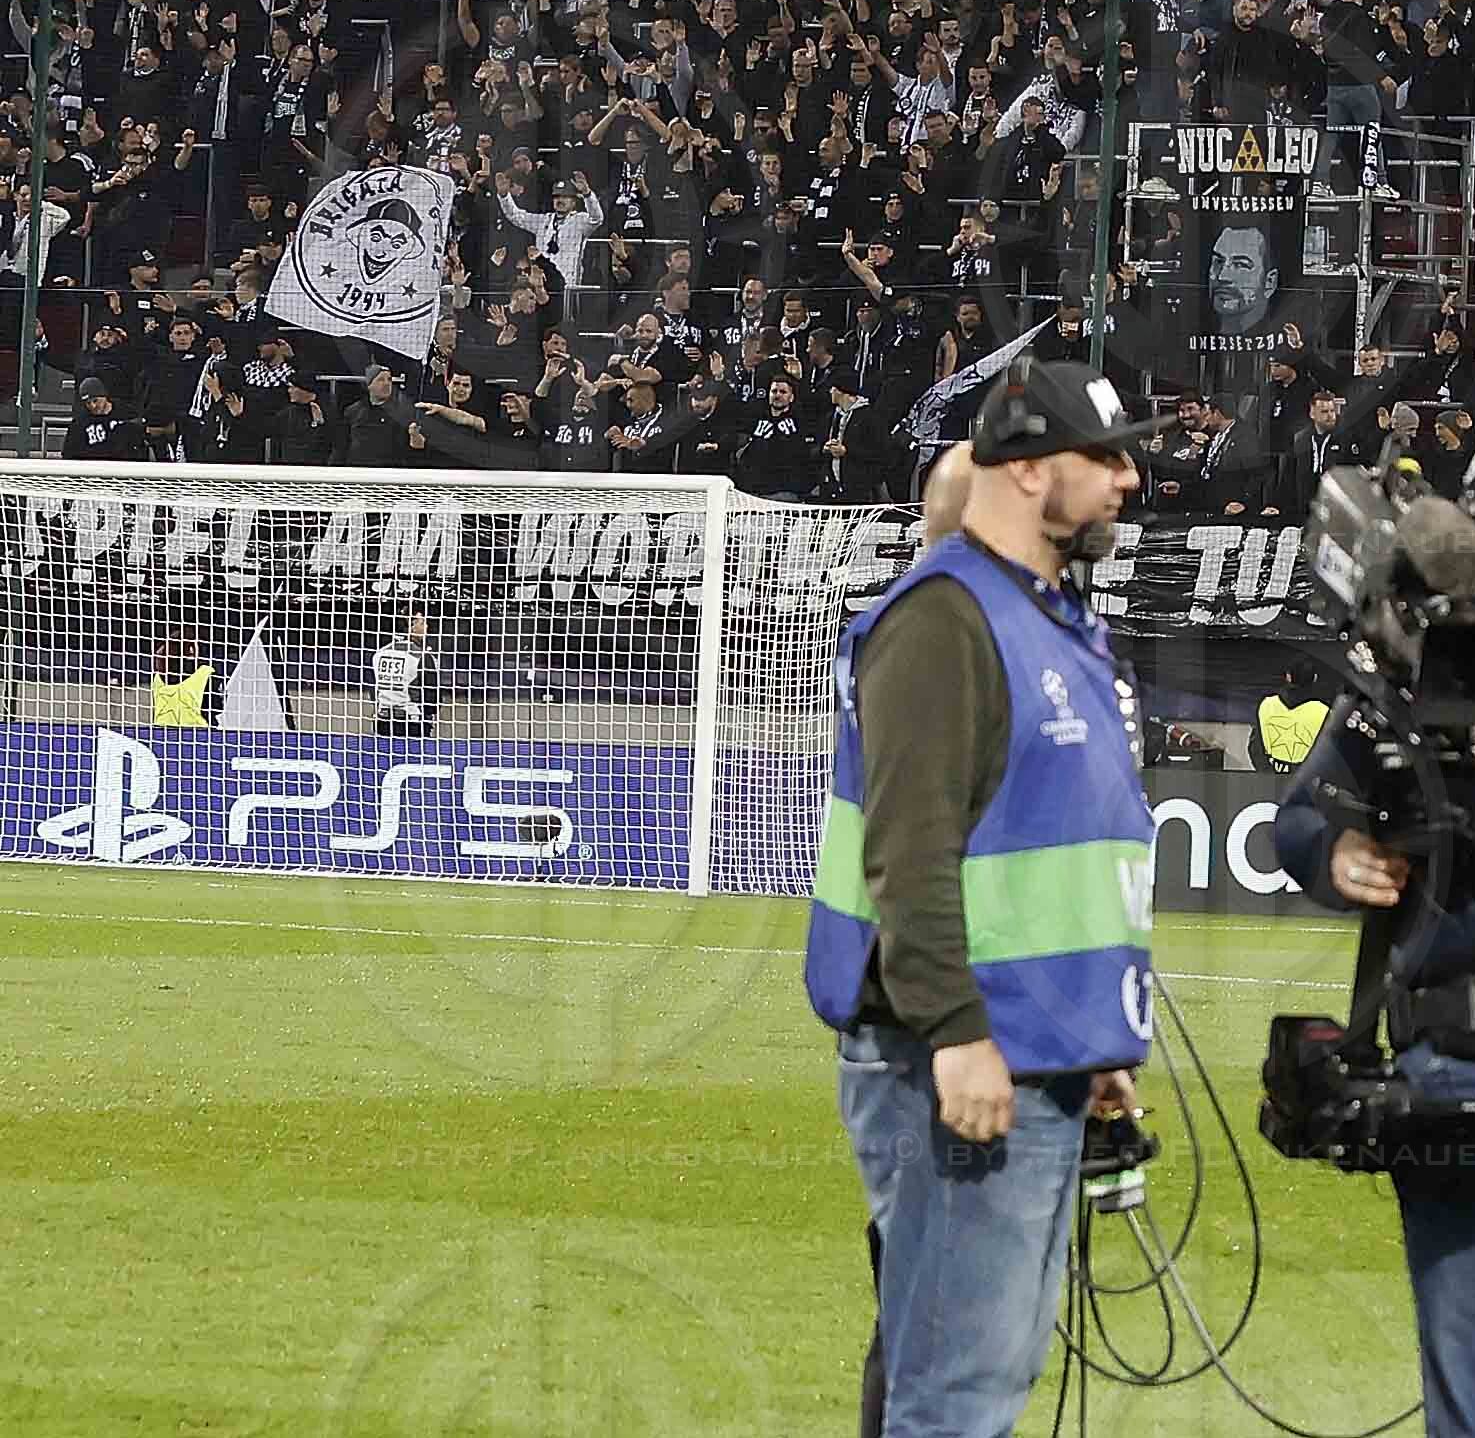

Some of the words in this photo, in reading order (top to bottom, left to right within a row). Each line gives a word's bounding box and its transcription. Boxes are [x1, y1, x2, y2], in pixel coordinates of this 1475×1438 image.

[308, 172, 404, 239] BRIGATA
[1191, 194, 1294, 213] UNVERGESSEN
[336, 281, 386, 311] 1994
[1188, 332, 1290, 352] UNERSETZBA
[228, 756, 576, 859] PS5
